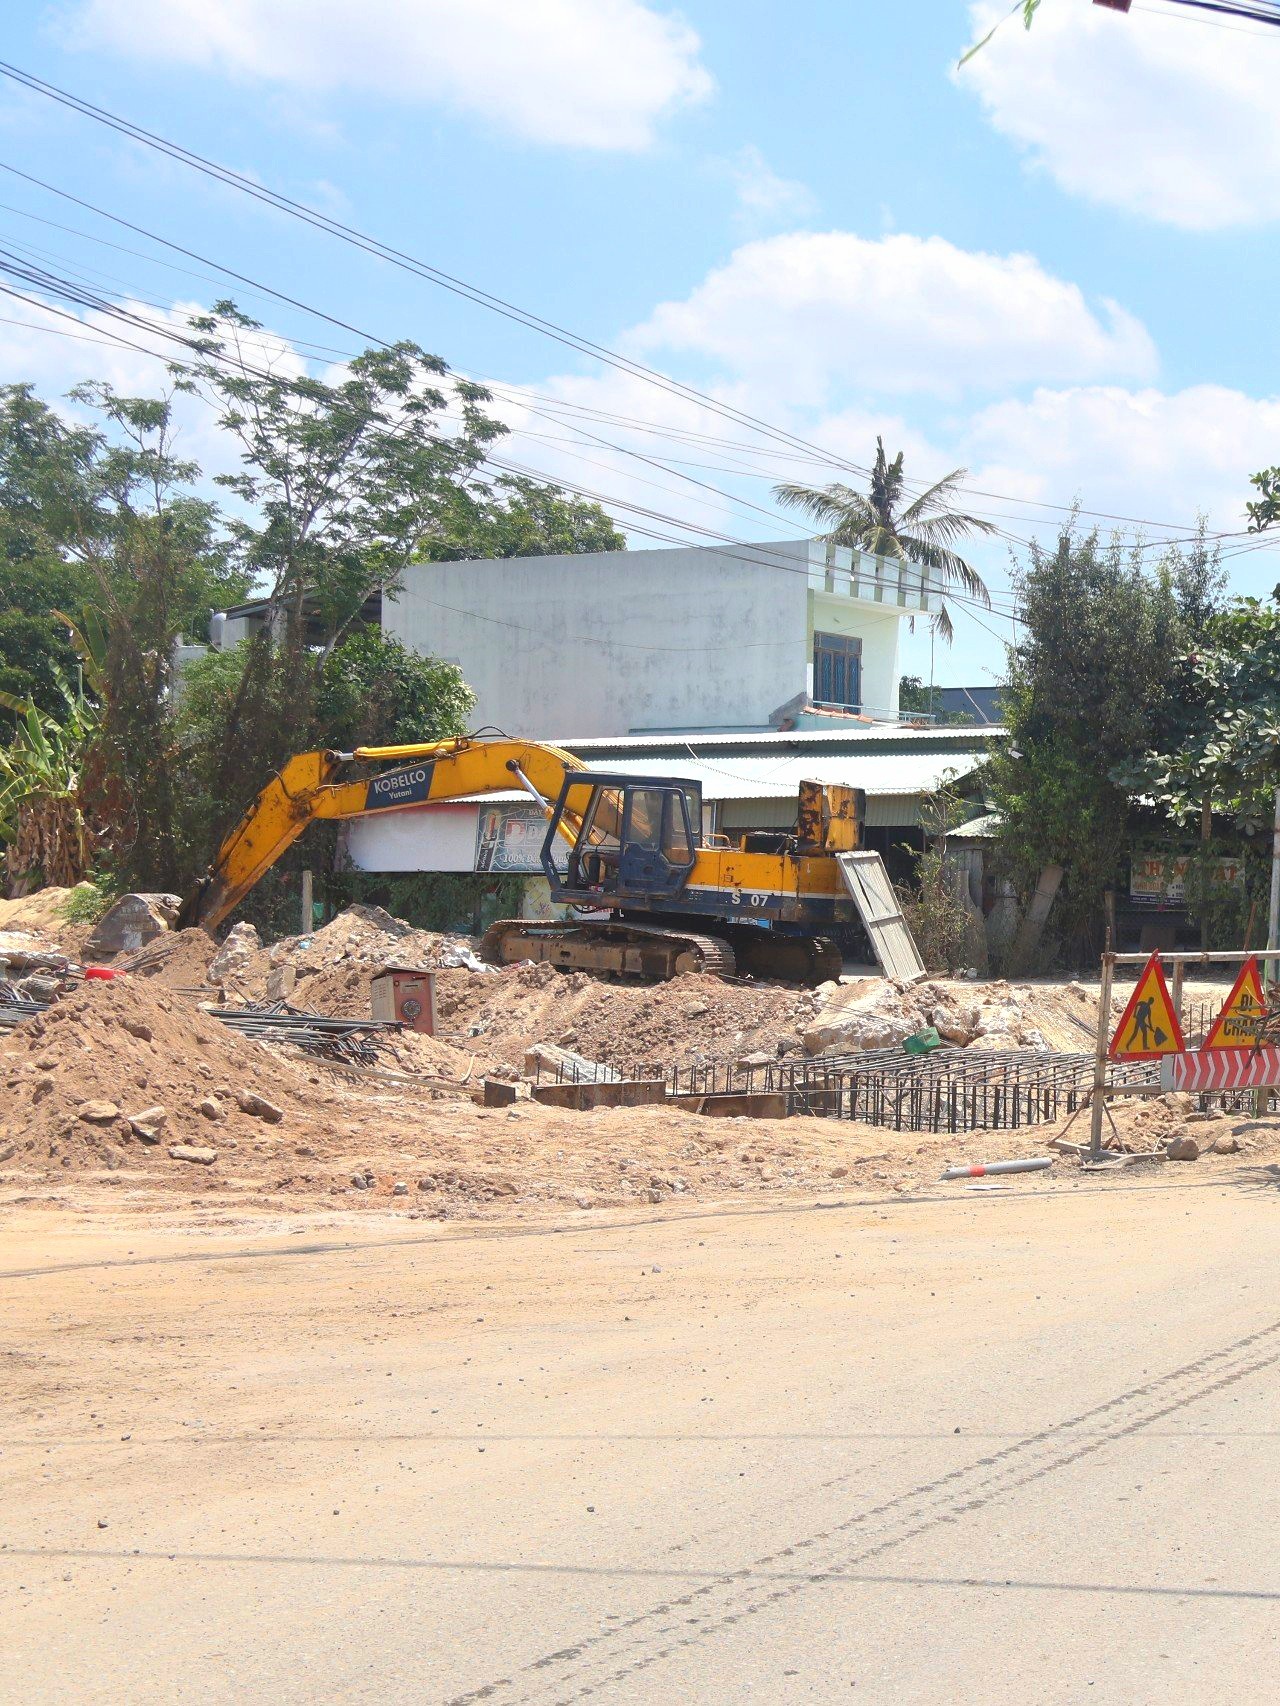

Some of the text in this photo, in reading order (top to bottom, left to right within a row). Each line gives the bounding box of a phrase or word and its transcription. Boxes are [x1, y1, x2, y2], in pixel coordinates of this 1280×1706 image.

[374, 769, 426, 794] KOBELCO
[389, 788, 412, 799] Yutani
[751, 895, 769, 907] 07
